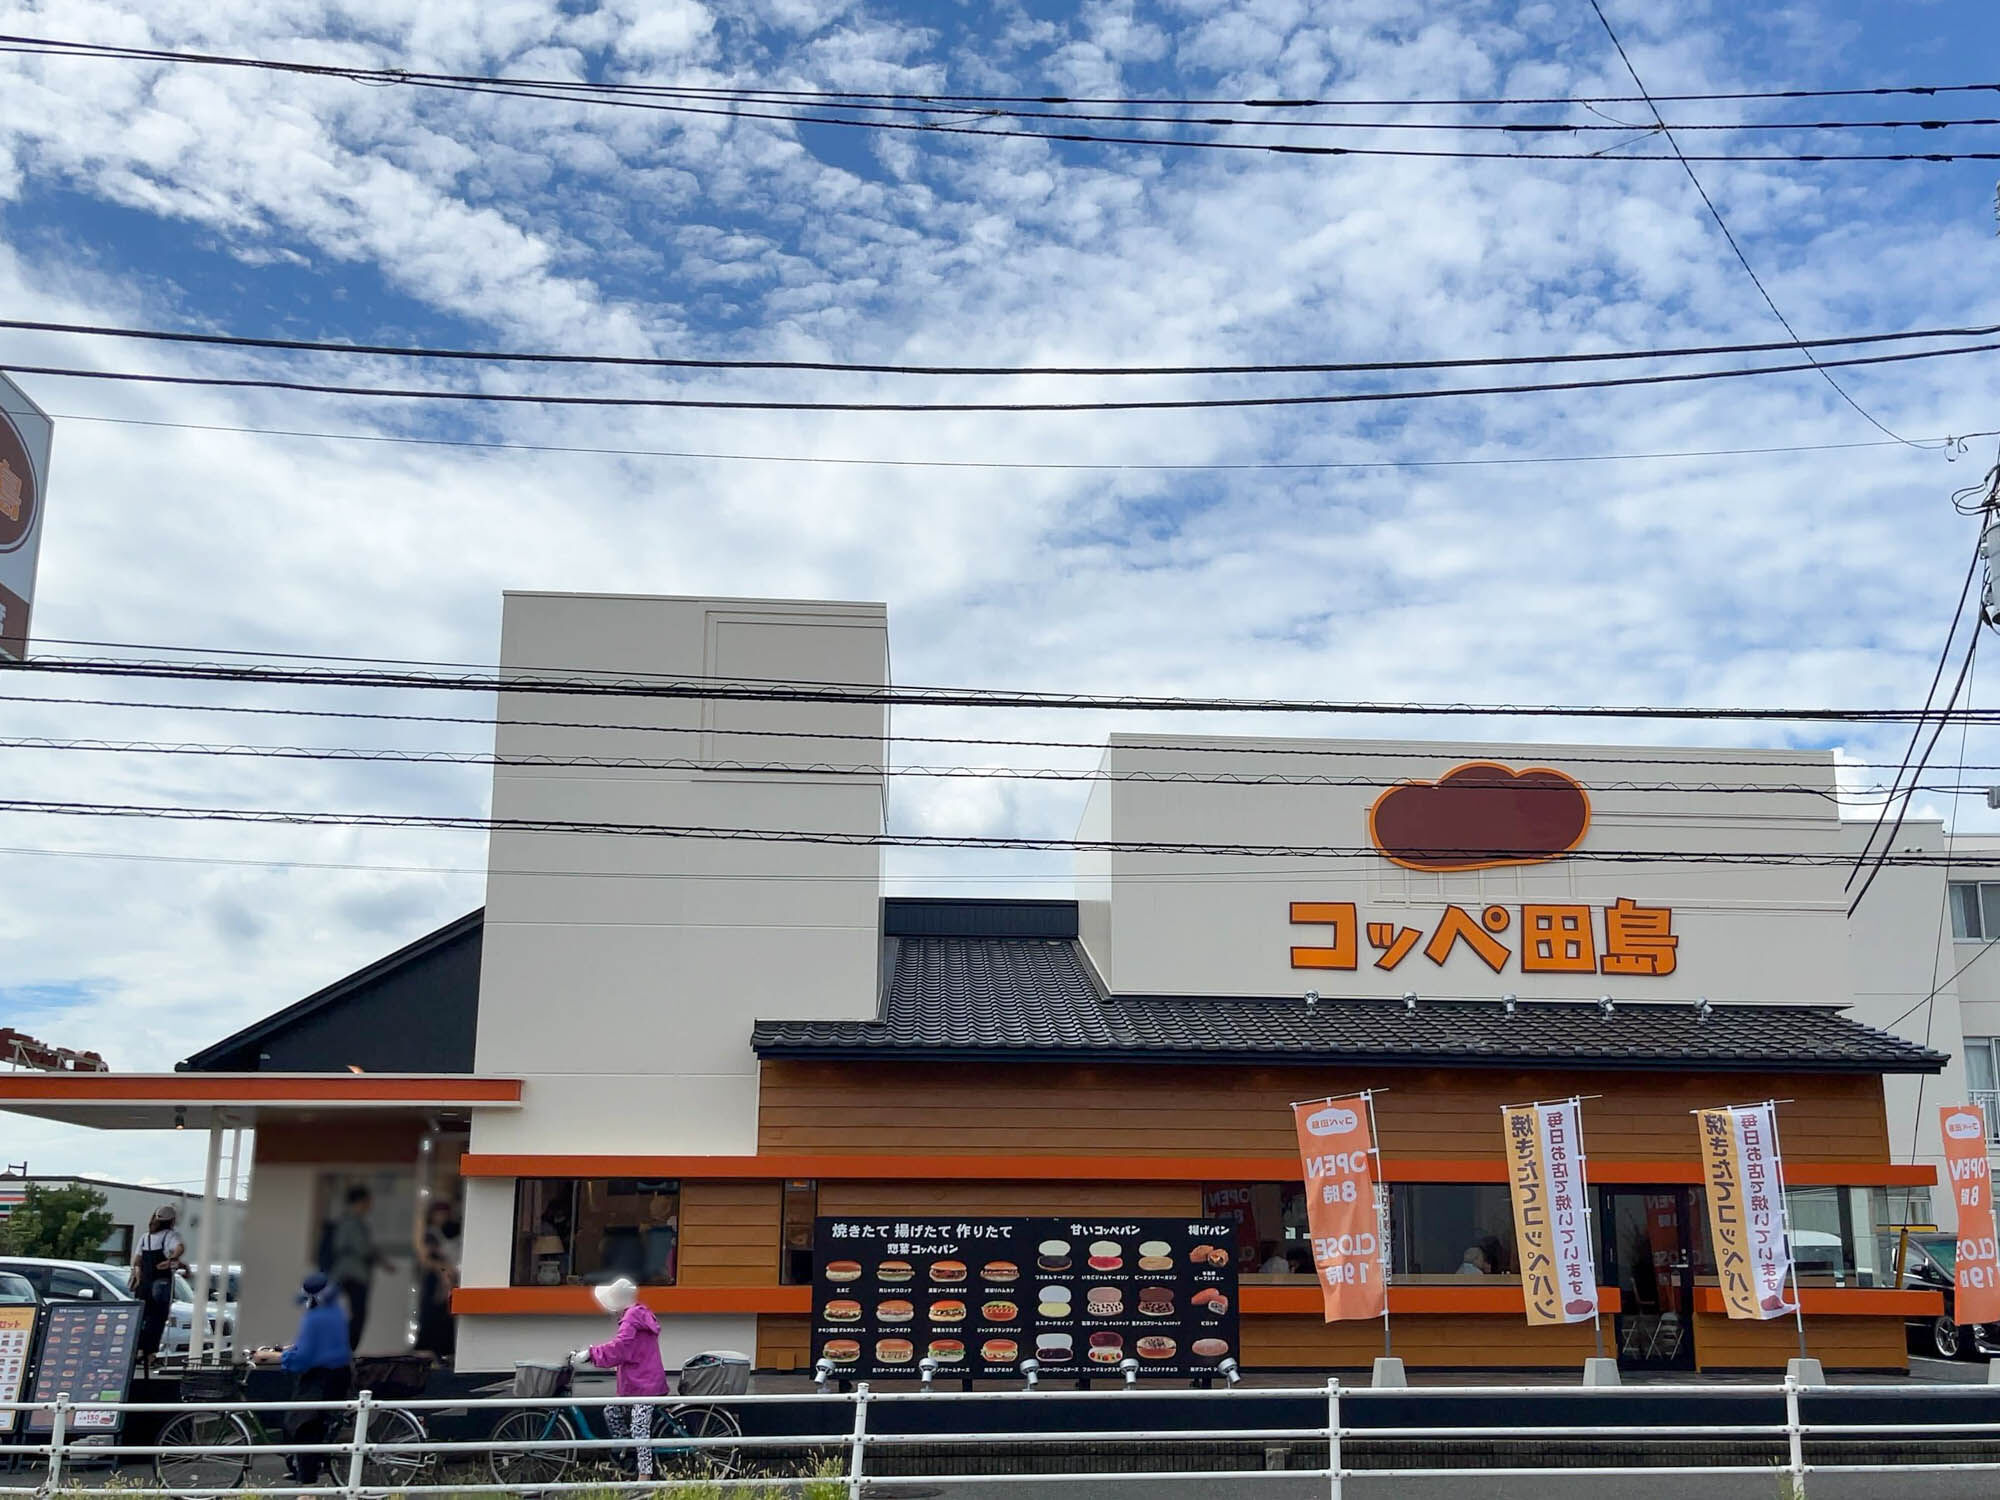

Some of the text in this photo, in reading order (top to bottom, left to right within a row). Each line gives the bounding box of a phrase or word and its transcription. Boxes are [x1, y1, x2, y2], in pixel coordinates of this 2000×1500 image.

[1289, 896, 1679, 976] コッペ田島
[832, 1223, 1013, 1238] 焼きたて 揚げたて 作りたて
[1070, 1223, 1141, 1236] 甘いコッペパン
[1188, 1224, 1230, 1236] 揚げパン
